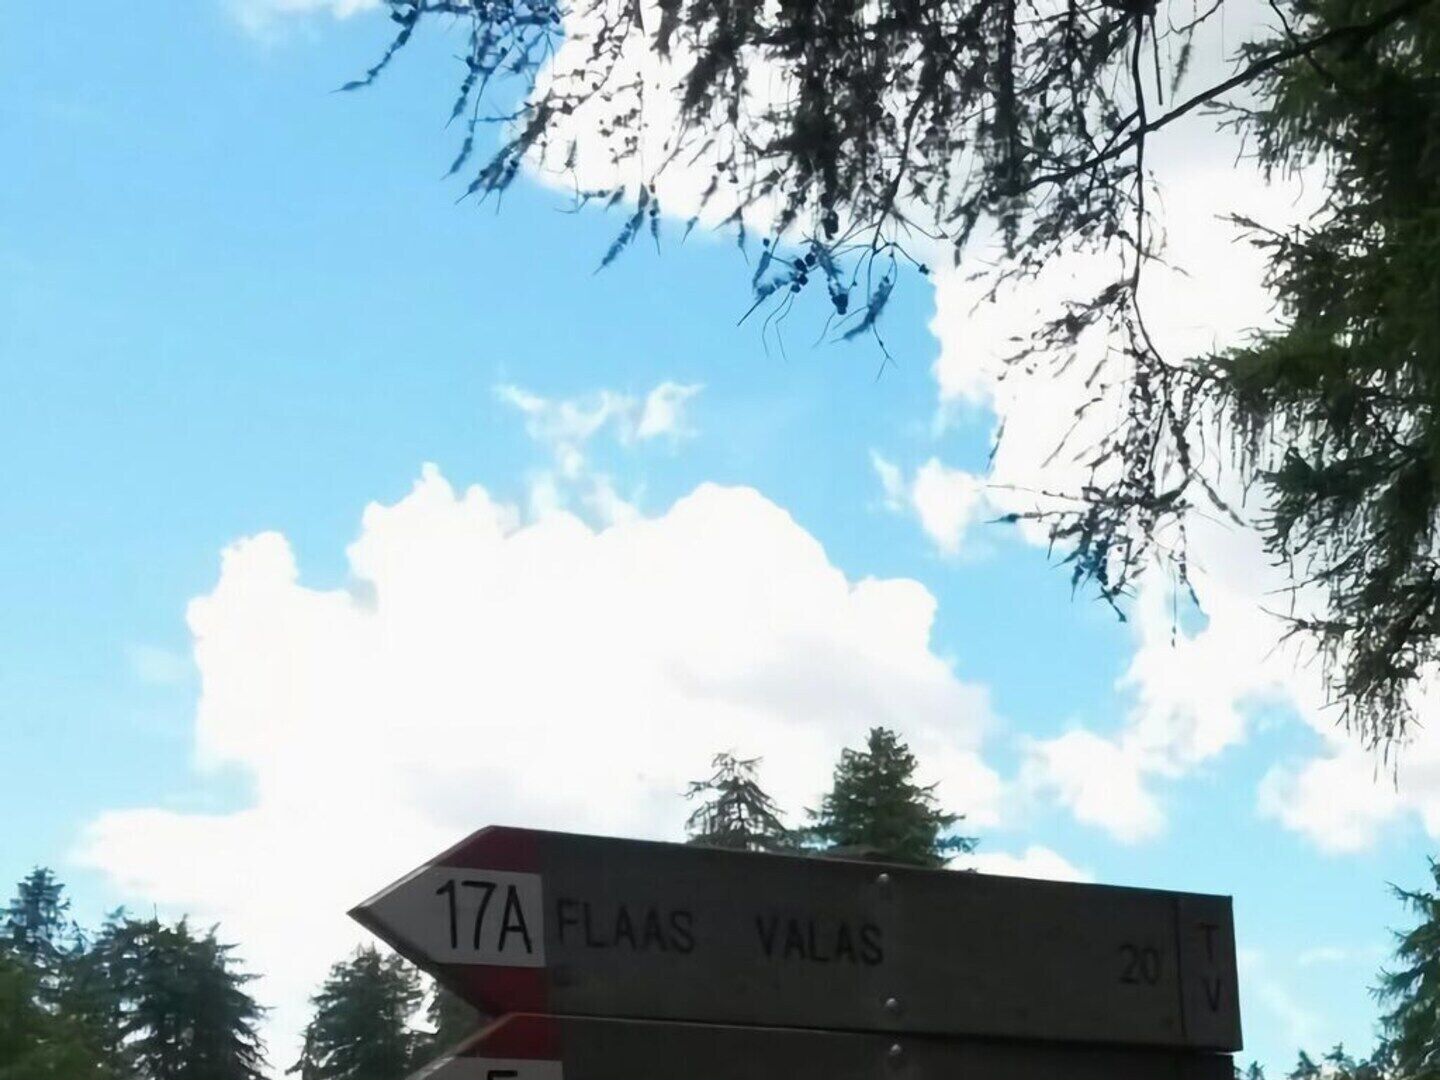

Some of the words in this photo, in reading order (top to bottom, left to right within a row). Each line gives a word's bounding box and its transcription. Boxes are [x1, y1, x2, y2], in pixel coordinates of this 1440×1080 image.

[436, 879, 532, 955] 17A
[556, 898, 696, 955] FLAAS
[756, 914, 884, 967] VALAS
